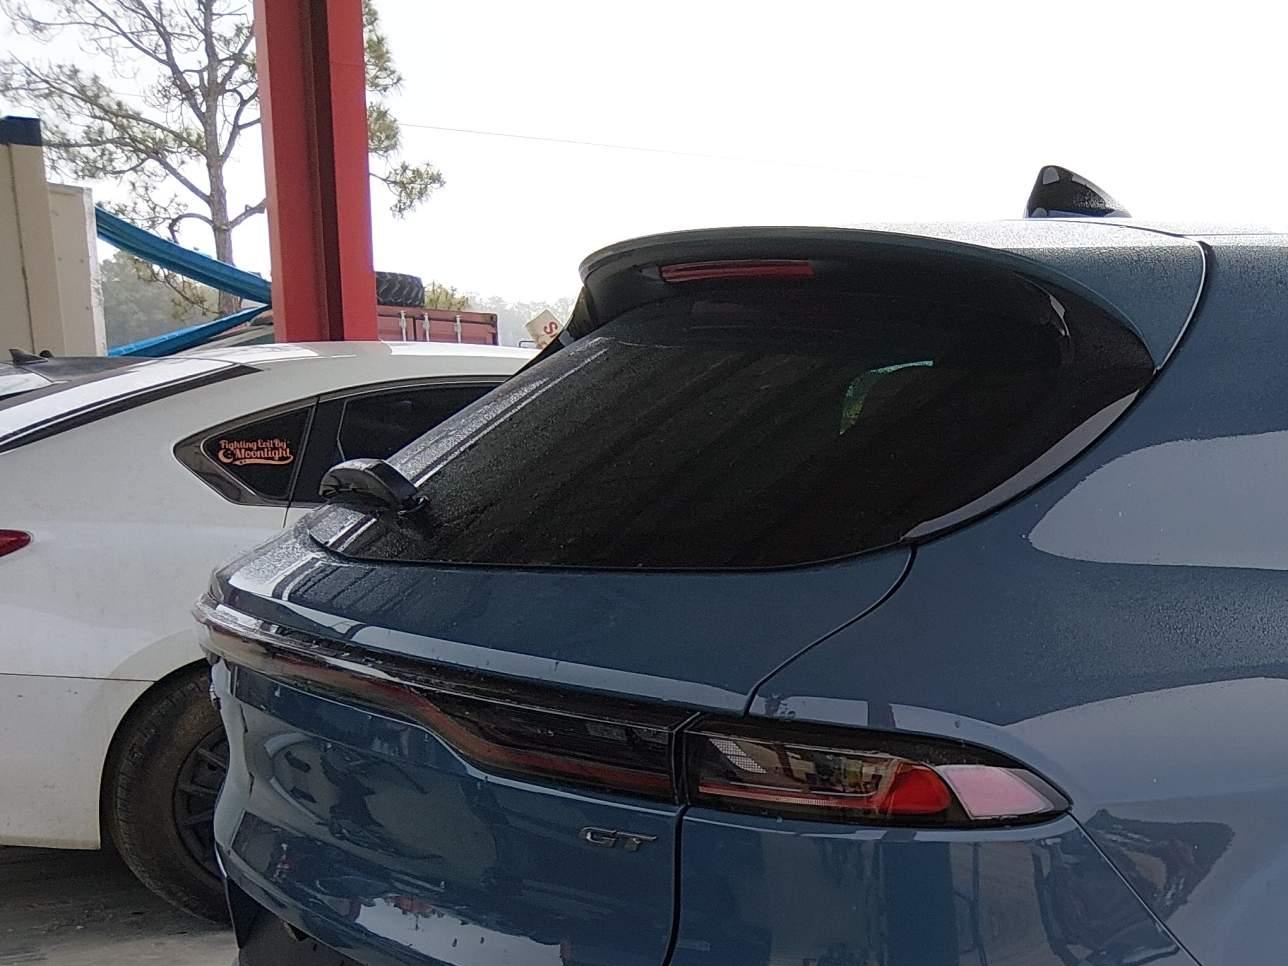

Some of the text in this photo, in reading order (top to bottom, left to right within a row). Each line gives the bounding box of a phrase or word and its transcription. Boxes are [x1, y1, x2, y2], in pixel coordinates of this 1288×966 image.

[543, 320, 559, 338] S
[219, 439, 257, 450] Fighting
[258, 439, 273, 448] Evil
[234, 447, 290, 460] Moonlight
[579, 826, 657, 852] GT
